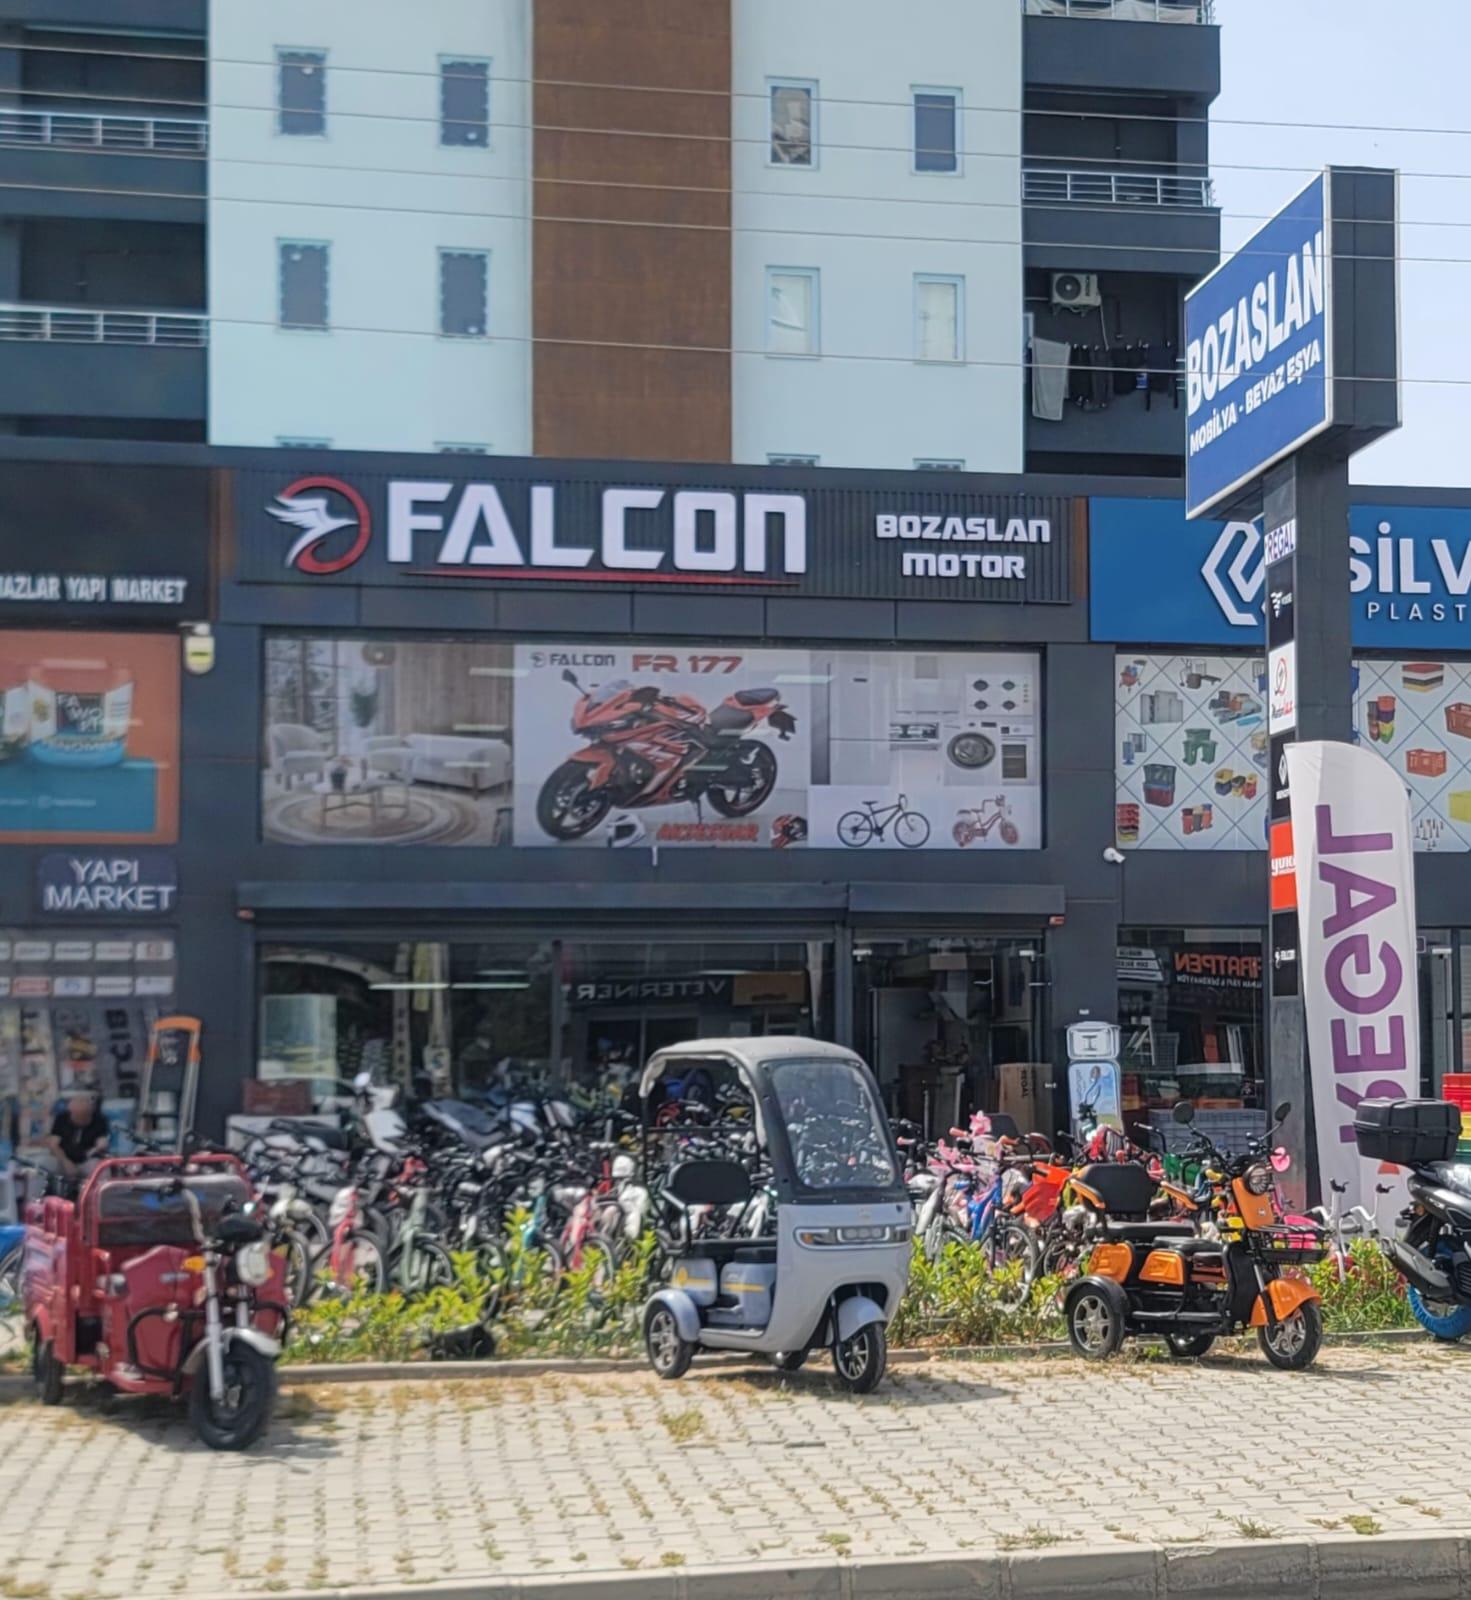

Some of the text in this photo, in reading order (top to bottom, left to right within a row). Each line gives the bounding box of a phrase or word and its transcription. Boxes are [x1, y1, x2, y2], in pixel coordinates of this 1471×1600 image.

[1187, 229, 1324, 417] BOZASLAN
[1190, 403, 1237, 456] MOBİLYA
[1245, 364, 1286, 416] BEYAZ
[1287, 338, 1321, 385] EŞYA
[387, 480, 807, 574] FALCON
[876, 514, 1051, 543] BOZASLAN
[902, 552, 1026, 580] MOTOR
[0, 575, 187, 603] AZLAR YAPI MARKET
[1367, 601, 1468, 622] PLAST
[550, 653, 616, 667] FALCON
[632, 654, 743, 675] FR 177
[70, 858, 140, 883] YAPI
[43, 884, 177, 911] MARKET
